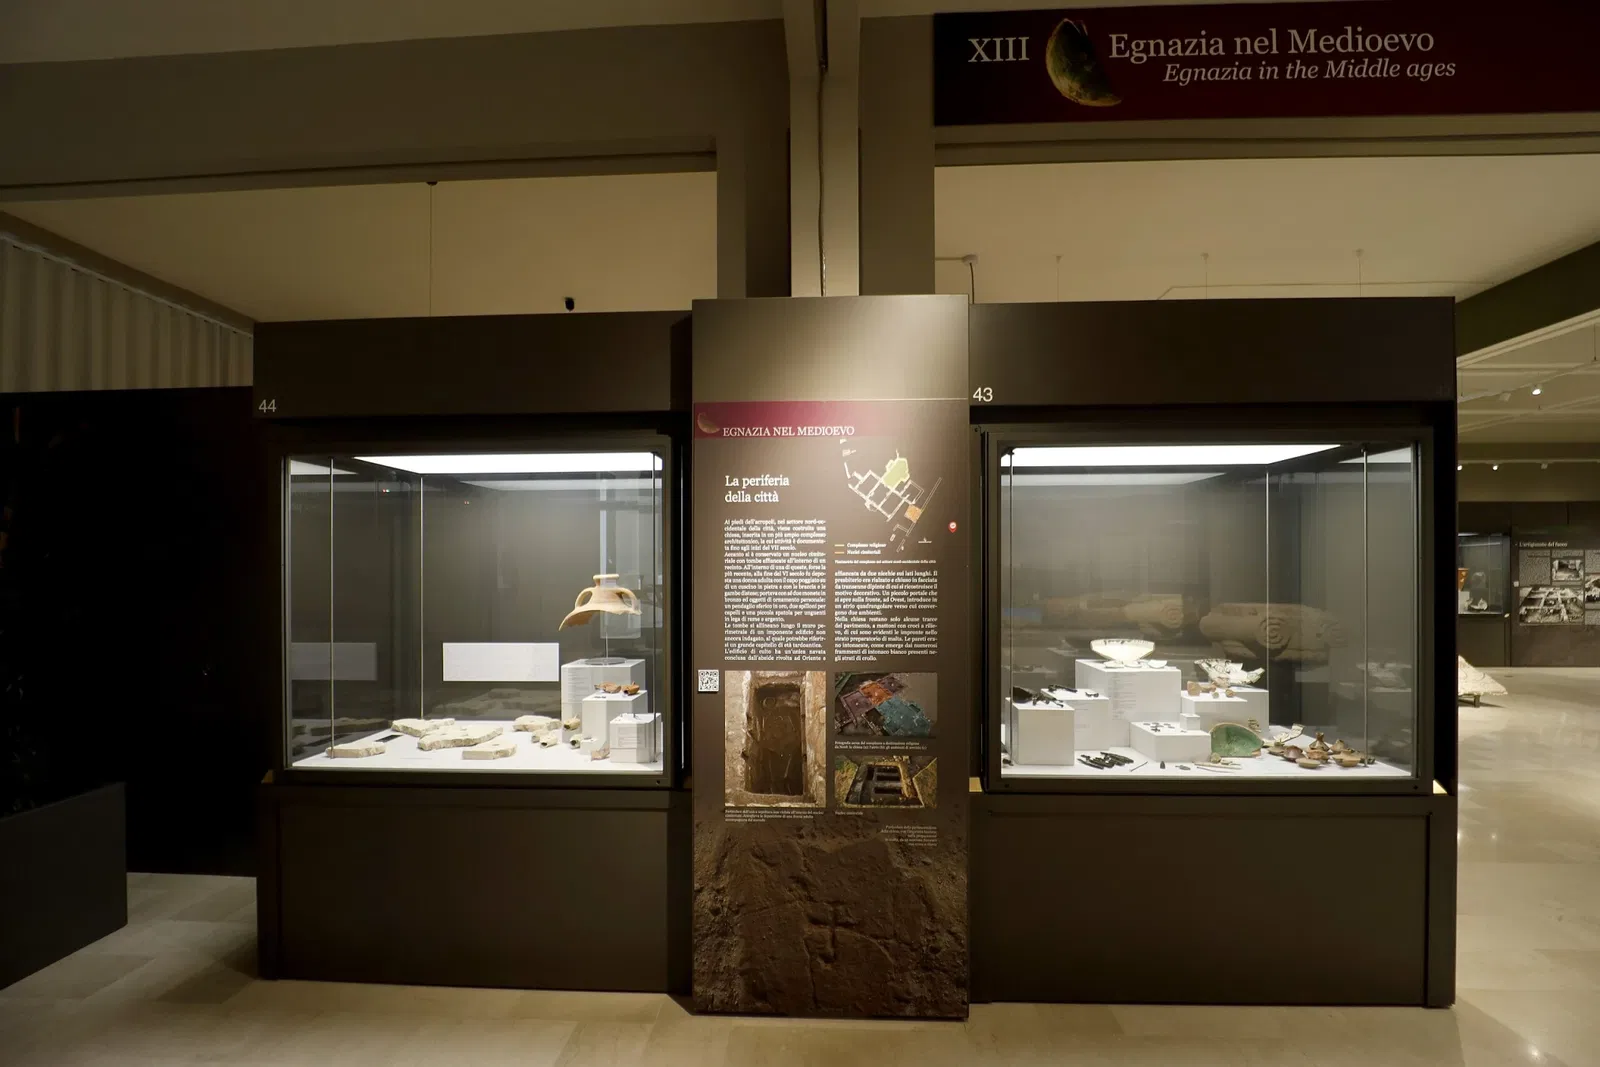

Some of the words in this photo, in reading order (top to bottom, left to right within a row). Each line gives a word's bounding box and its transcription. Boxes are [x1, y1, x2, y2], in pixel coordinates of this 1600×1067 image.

[968, 37, 1030, 62] XIII
[1109, 30, 1225, 64] Egnazia
[1234, 28, 1279, 55] nel
[1288, 26, 1434, 54] Medioevo
[1163, 61, 1252, 86] Egnazia
[1259, 61, 1279, 80] in
[1286, 60, 1318, 79] the
[1324, 58, 1400, 78] Middle
[1407, 62, 1456, 82] ages
[972, 387, 993, 402] 43
[258, 399, 277, 413] 44
[723, 427, 770, 437] EGNAZIA
[773, 427, 796, 436] NEL
[797, 426, 855, 436] MEDIOEVO
[725, 475, 739, 486] La
[742, 475, 790, 489] periferia
[725, 491, 751, 502] della
[755, 491, 779, 502] città
